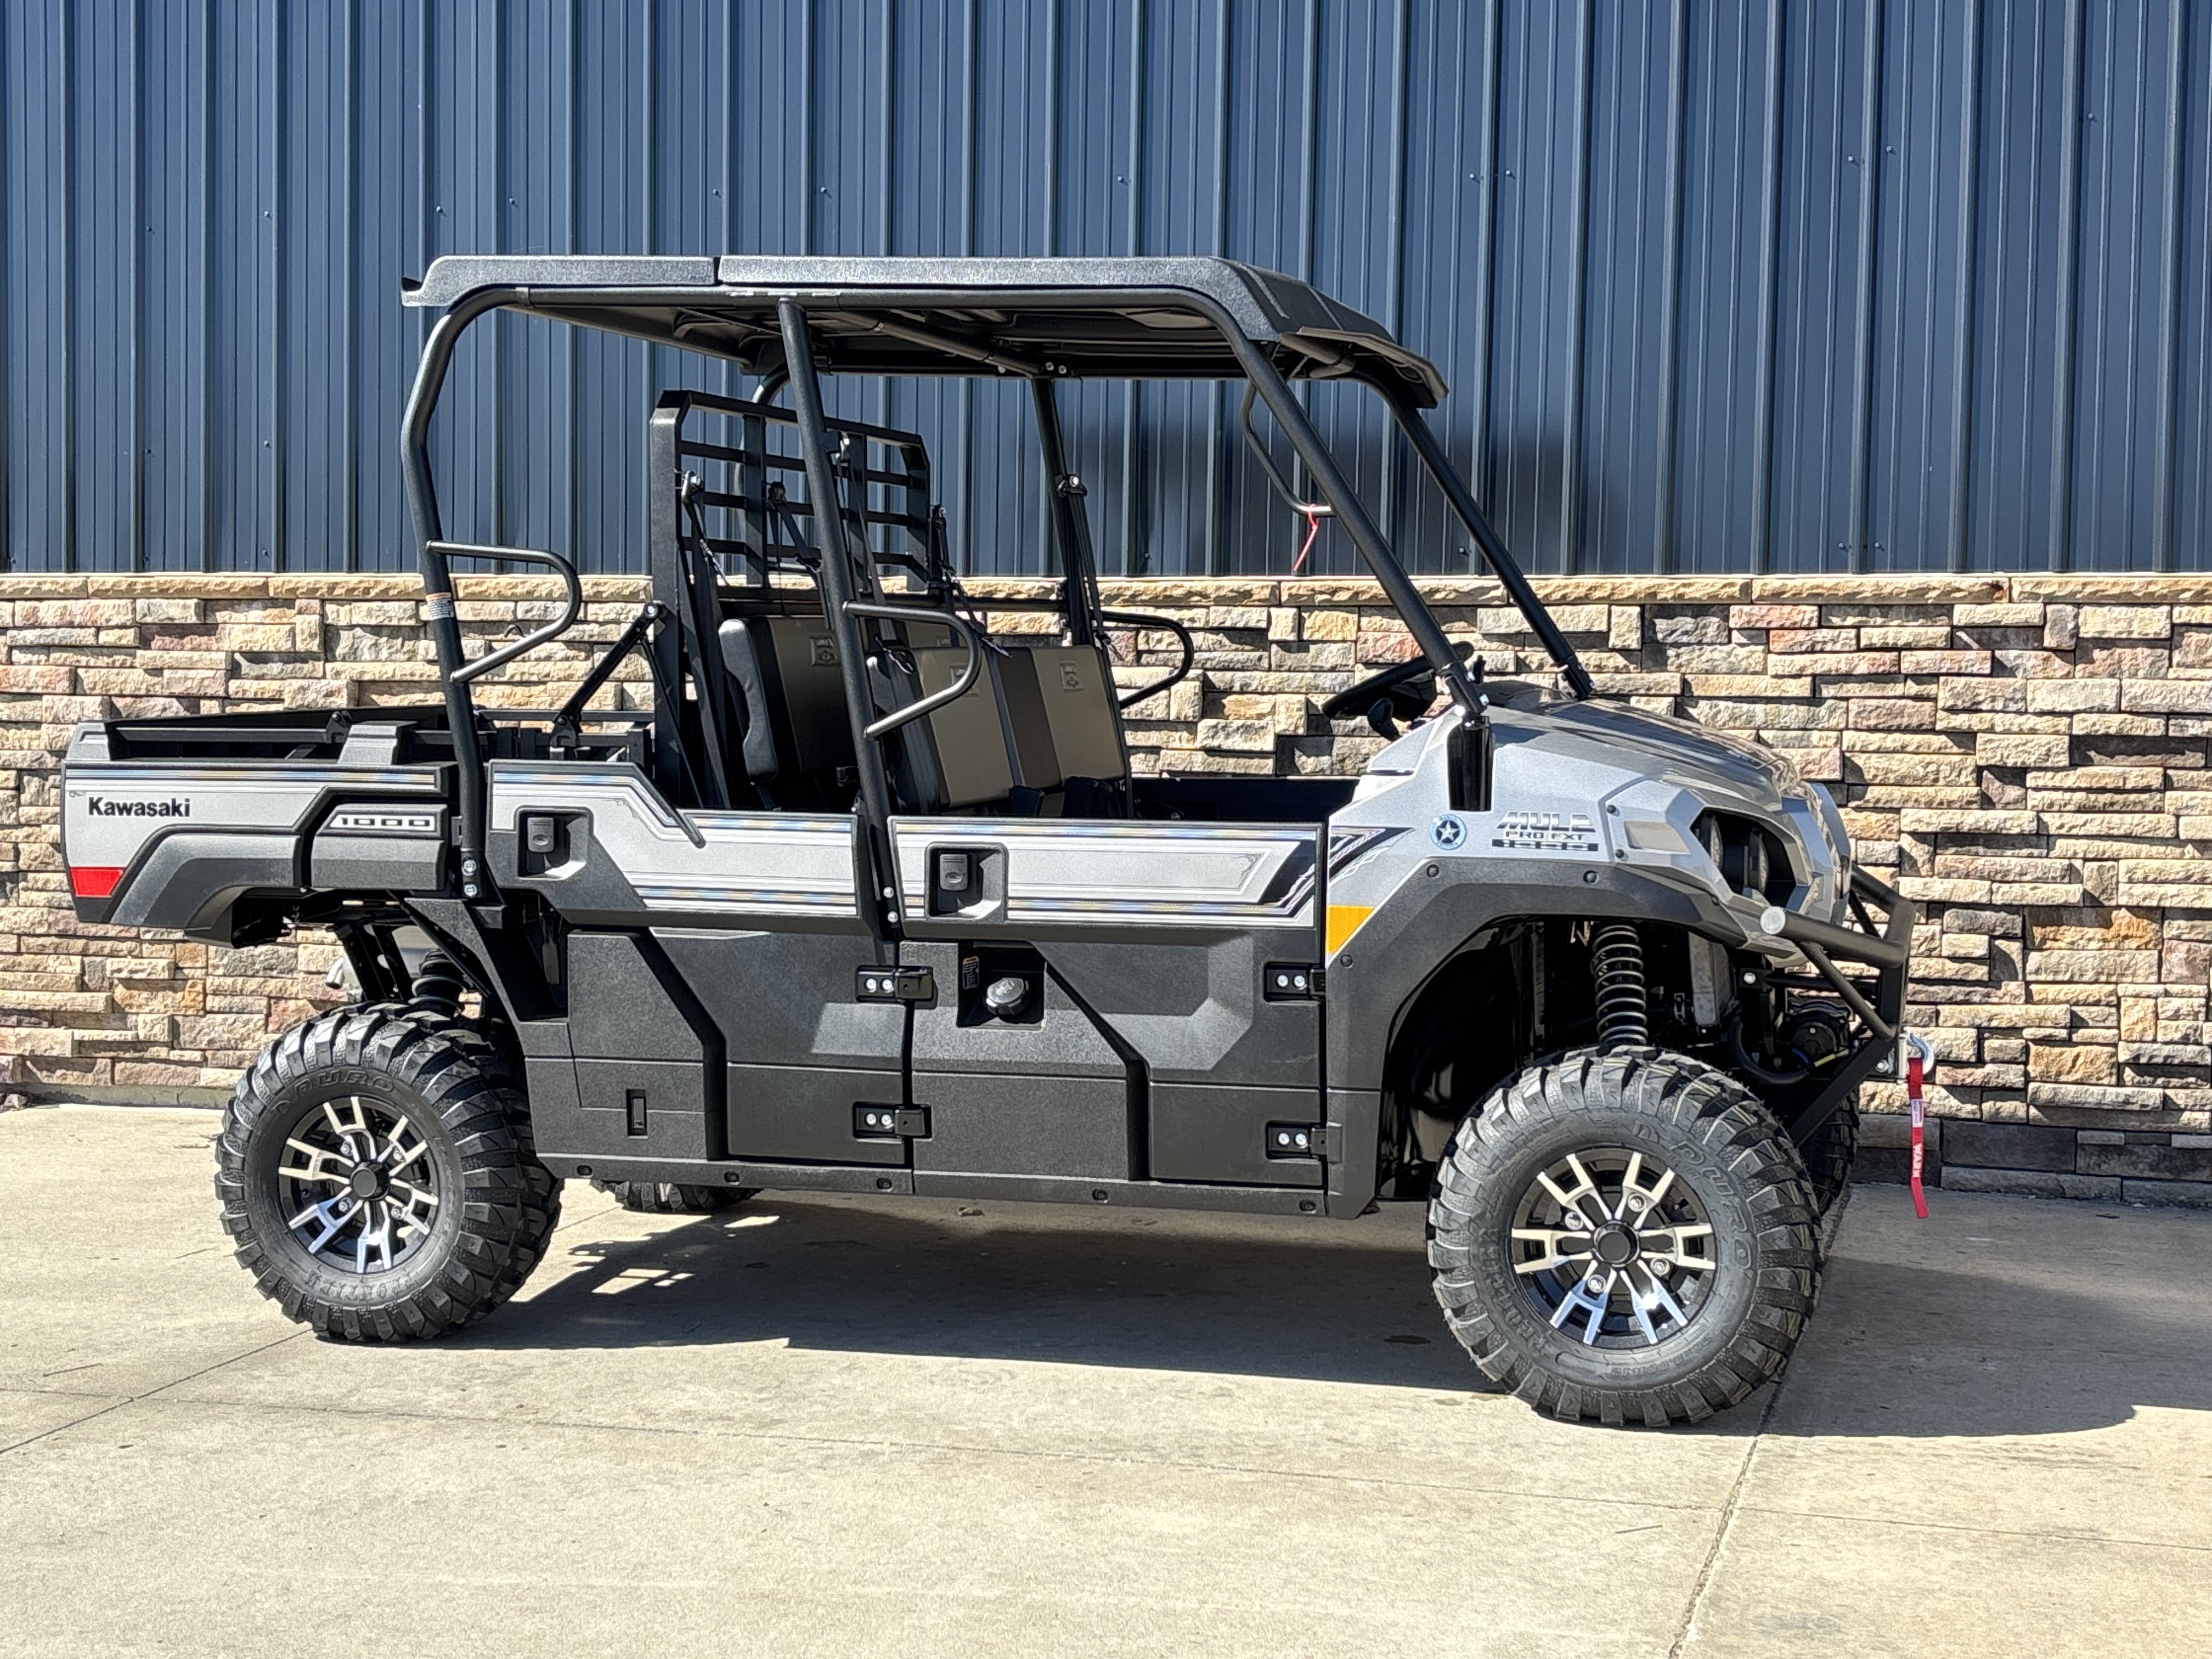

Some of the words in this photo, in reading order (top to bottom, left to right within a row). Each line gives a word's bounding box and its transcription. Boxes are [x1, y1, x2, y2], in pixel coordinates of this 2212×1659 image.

[88, 796, 190, 817] Kawasaki
[341, 817, 430, 827] 1000
[1496, 811, 1596, 833] MULE
[295, 1069, 394, 1096] DURO
[1912, 1143, 1923, 1177] WARN
[1669, 1141, 1751, 1269] DURO
